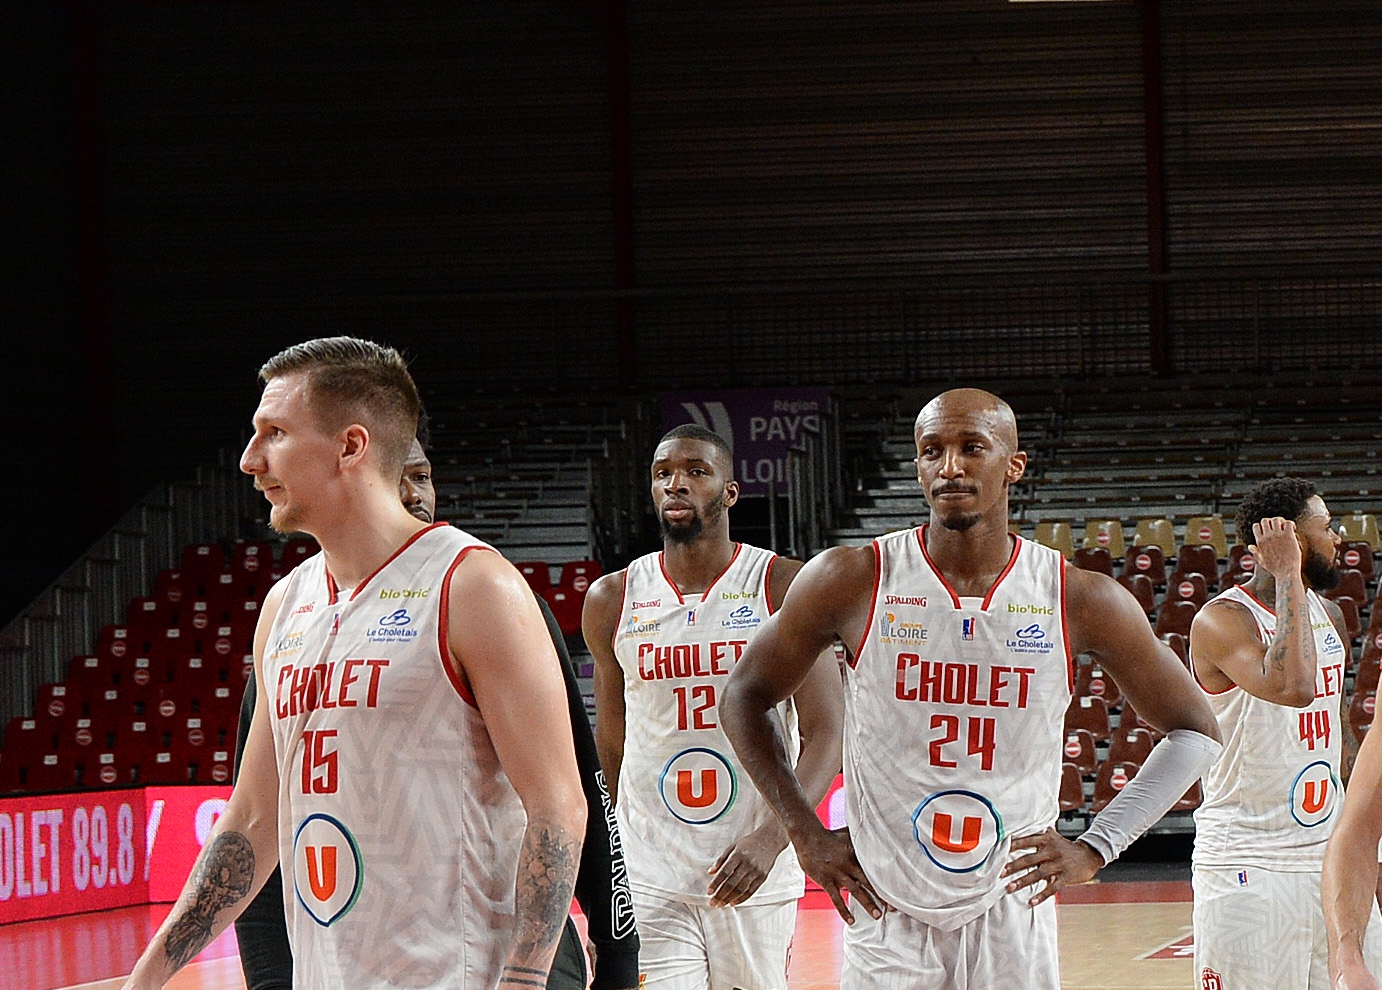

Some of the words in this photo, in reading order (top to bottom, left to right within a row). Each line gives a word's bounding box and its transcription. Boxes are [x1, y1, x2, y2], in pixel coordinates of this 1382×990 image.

[750, 416, 804, 442] PAY
[885, 595, 927, 607] SPALDING
[367, 629, 377, 637] Le
[890, 627, 928, 640] LOIRE
[1006, 639, 1016, 647] Le
[638, 640, 748, 681] CHOLET
[895, 653, 1036, 709] CHOLET
[276, 660, 390, 719] CHOLET
[673, 685, 717, 731] 12
[929, 714, 997, 771] 24
[1299, 710, 1331, 751] 44
[301, 729, 339, 795] 15
[72, 803, 136, 892] 89.8
